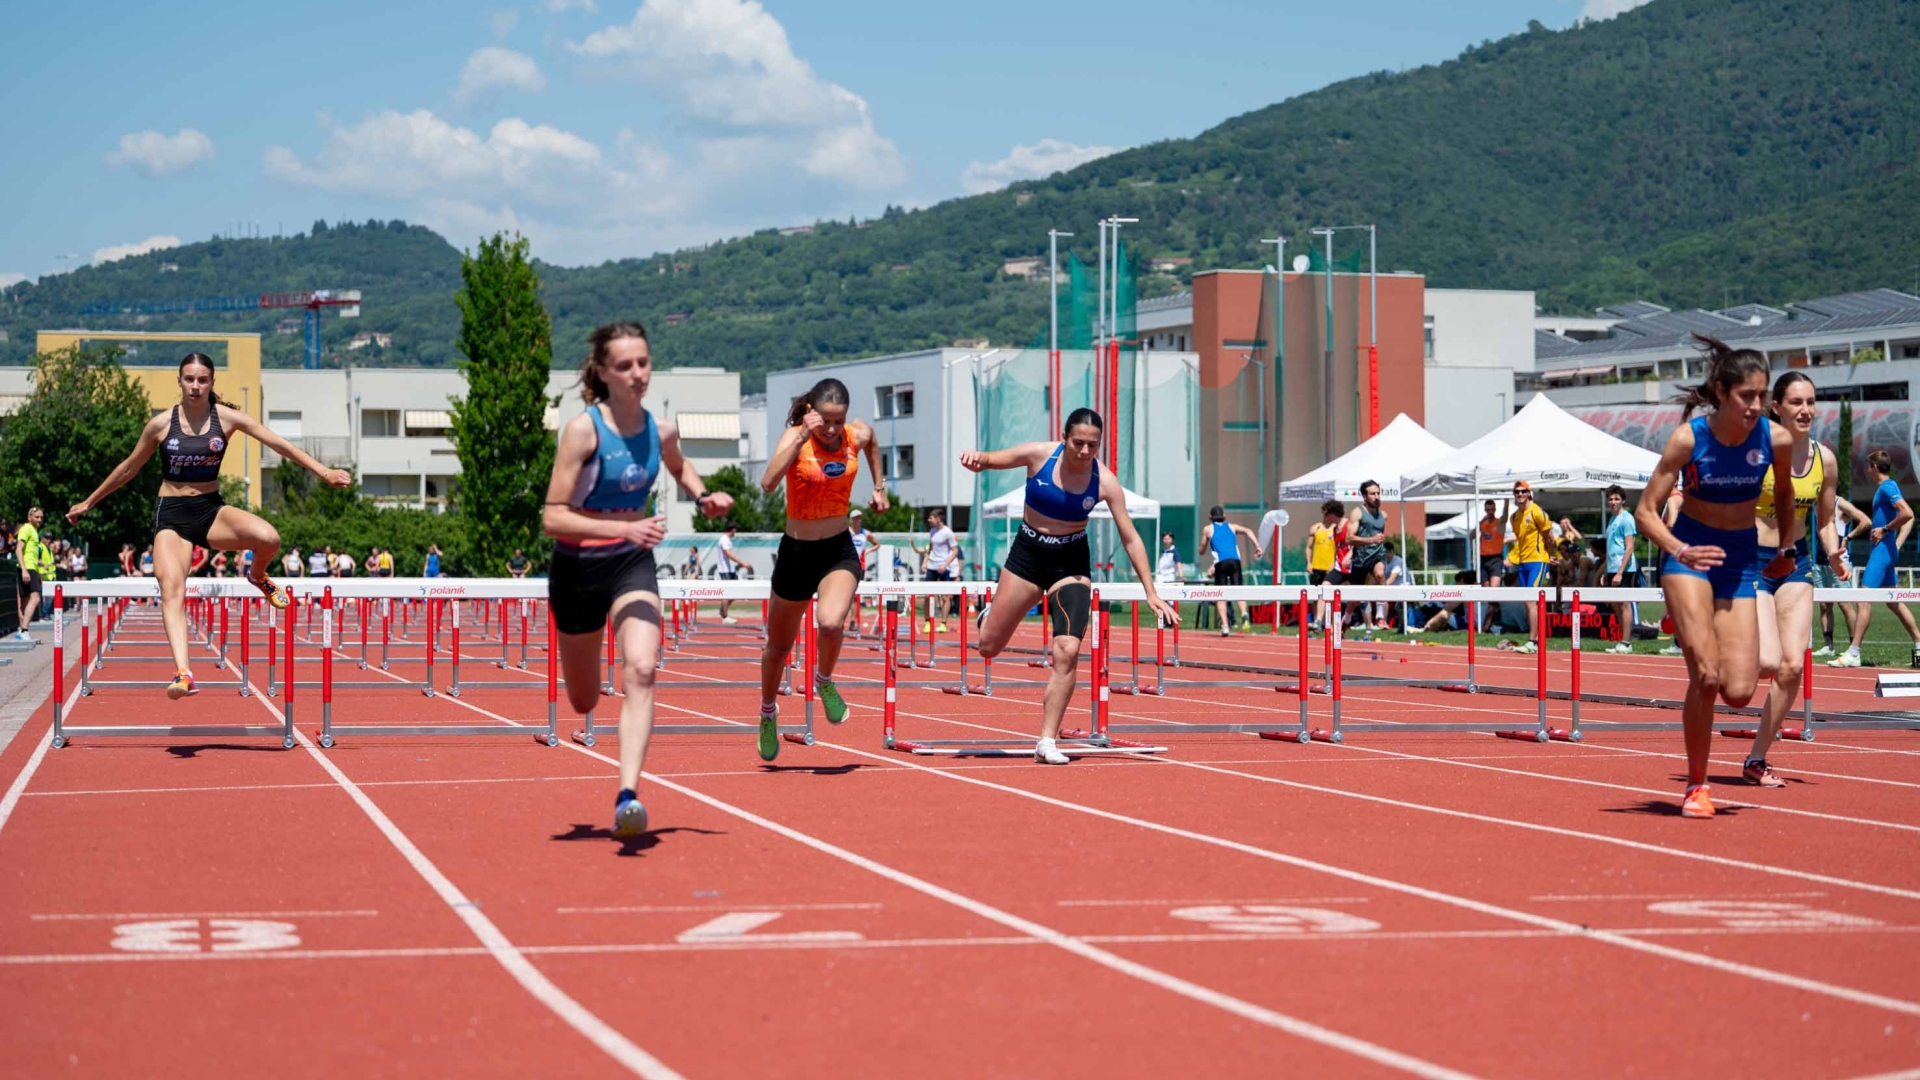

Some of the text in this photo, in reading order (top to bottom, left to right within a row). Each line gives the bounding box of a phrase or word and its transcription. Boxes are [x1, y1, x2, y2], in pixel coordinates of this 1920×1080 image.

[1540, 471, 1569, 480] Comitato
[1585, 471, 1621, 481] Provinciale
[1038, 534, 1071, 545] NIKE
[1071, 529, 1087, 542] PR
[430, 586, 465, 596] polanik
[689, 588, 724, 597] polanik
[1190, 589, 1223, 599] polanik
[1429, 590, 1463, 599] polanik
[1896, 591, 1920, 600] polan
[675, 912, 866, 943] 7
[110, 919, 302, 951] 8
